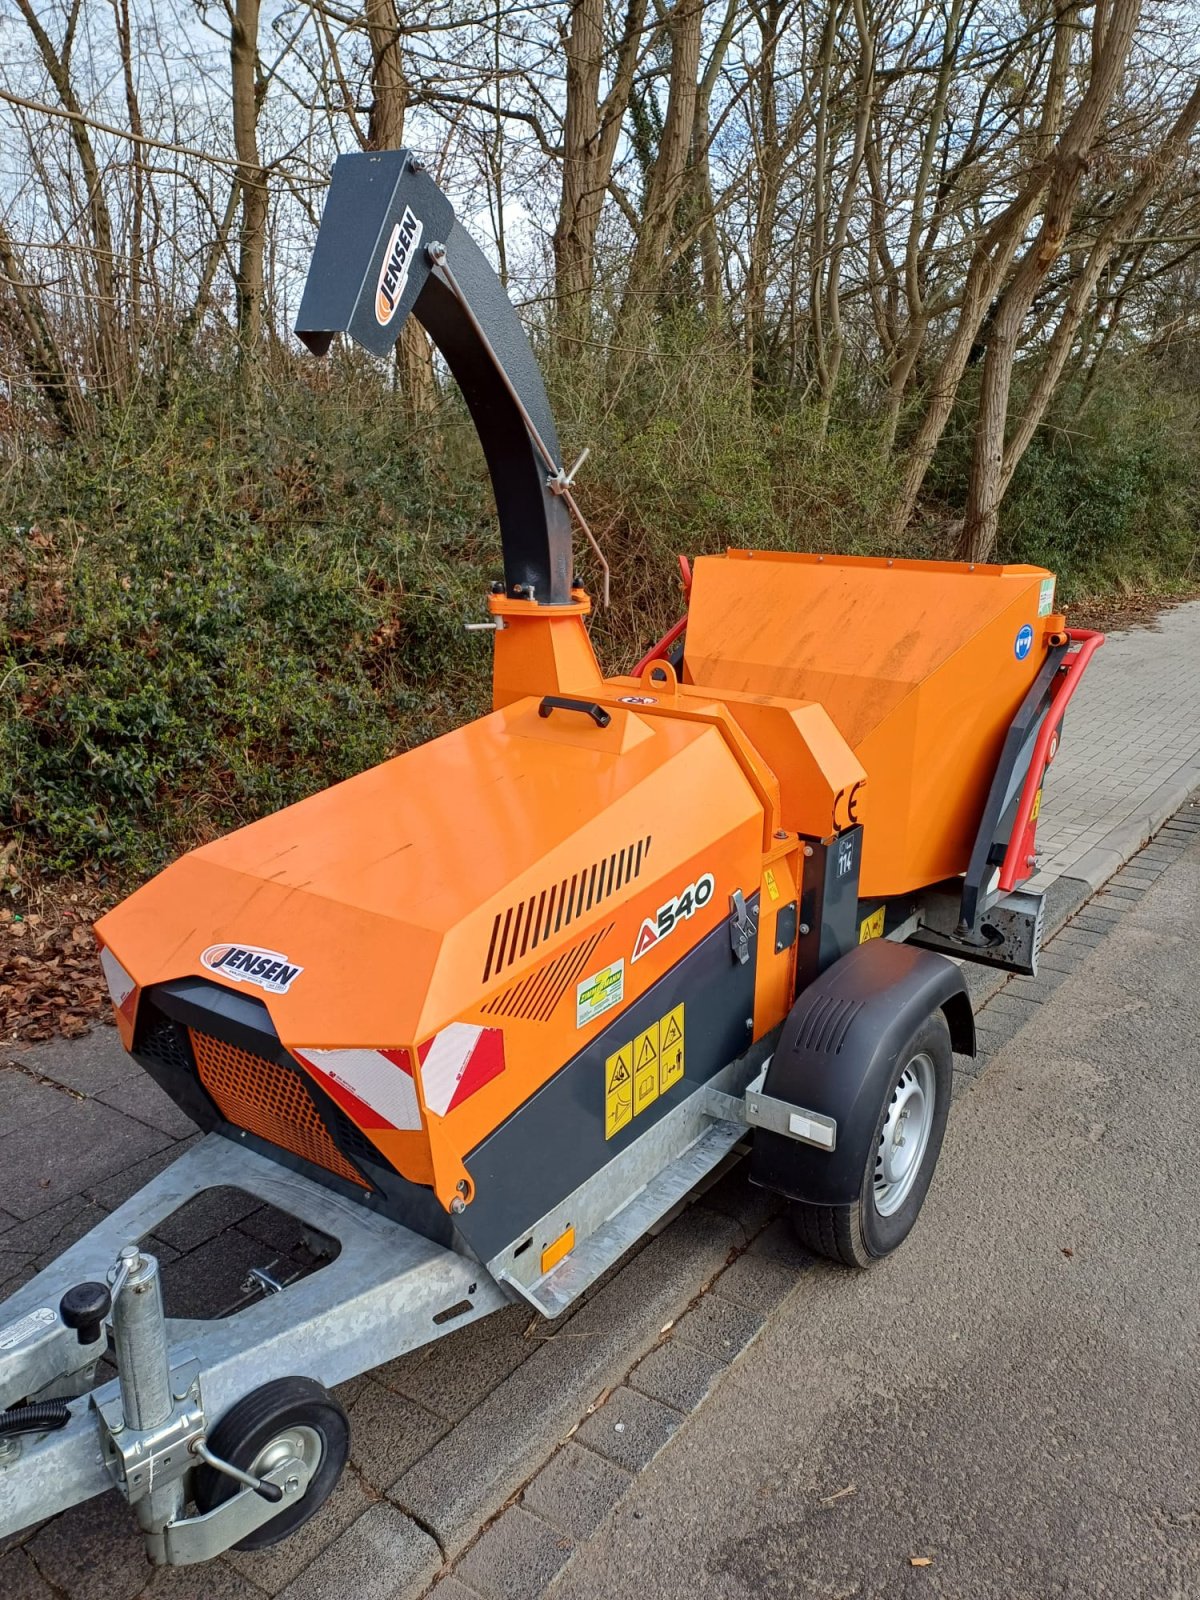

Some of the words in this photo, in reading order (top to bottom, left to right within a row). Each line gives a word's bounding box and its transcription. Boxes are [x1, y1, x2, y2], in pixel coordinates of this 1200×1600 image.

[380, 210, 418, 312] JENSEN
[832, 779, 866, 832] CE
[634, 878, 712, 958] A540
[210, 947, 299, 986] JENSEN
